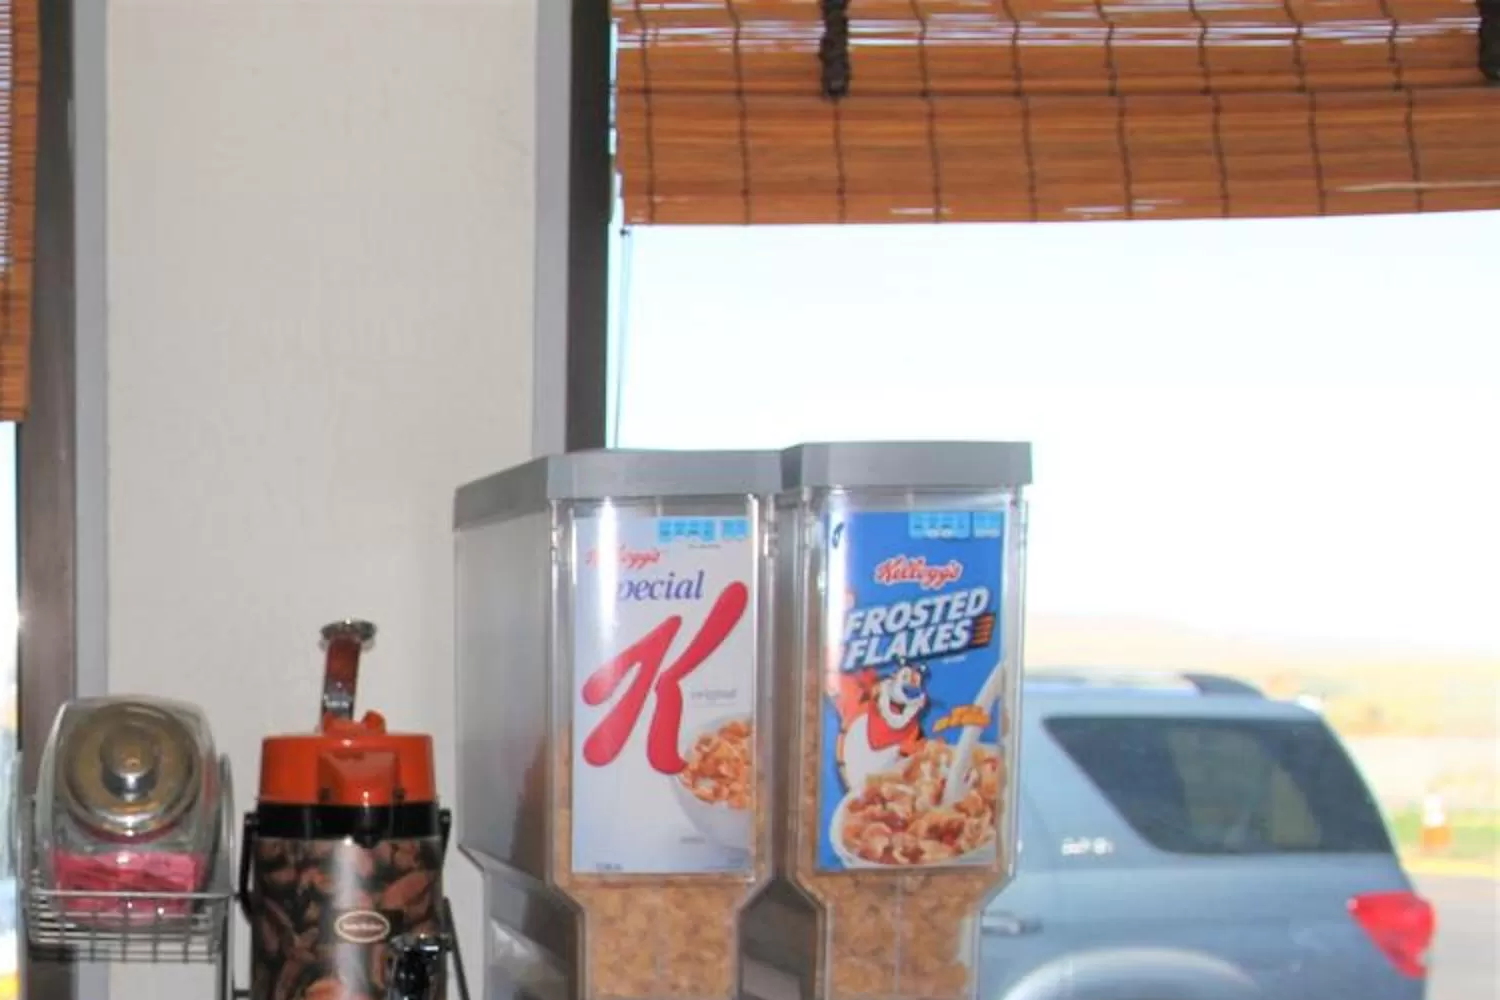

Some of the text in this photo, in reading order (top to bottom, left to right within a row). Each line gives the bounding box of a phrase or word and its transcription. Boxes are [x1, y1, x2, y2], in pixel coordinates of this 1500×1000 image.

[618, 569, 705, 601] pecial
[875, 554, 963, 590] Kellogg's
[842, 586, 991, 642] FROSTED
[843, 618, 973, 670] FLAKES
[582, 580, 749, 775] K
